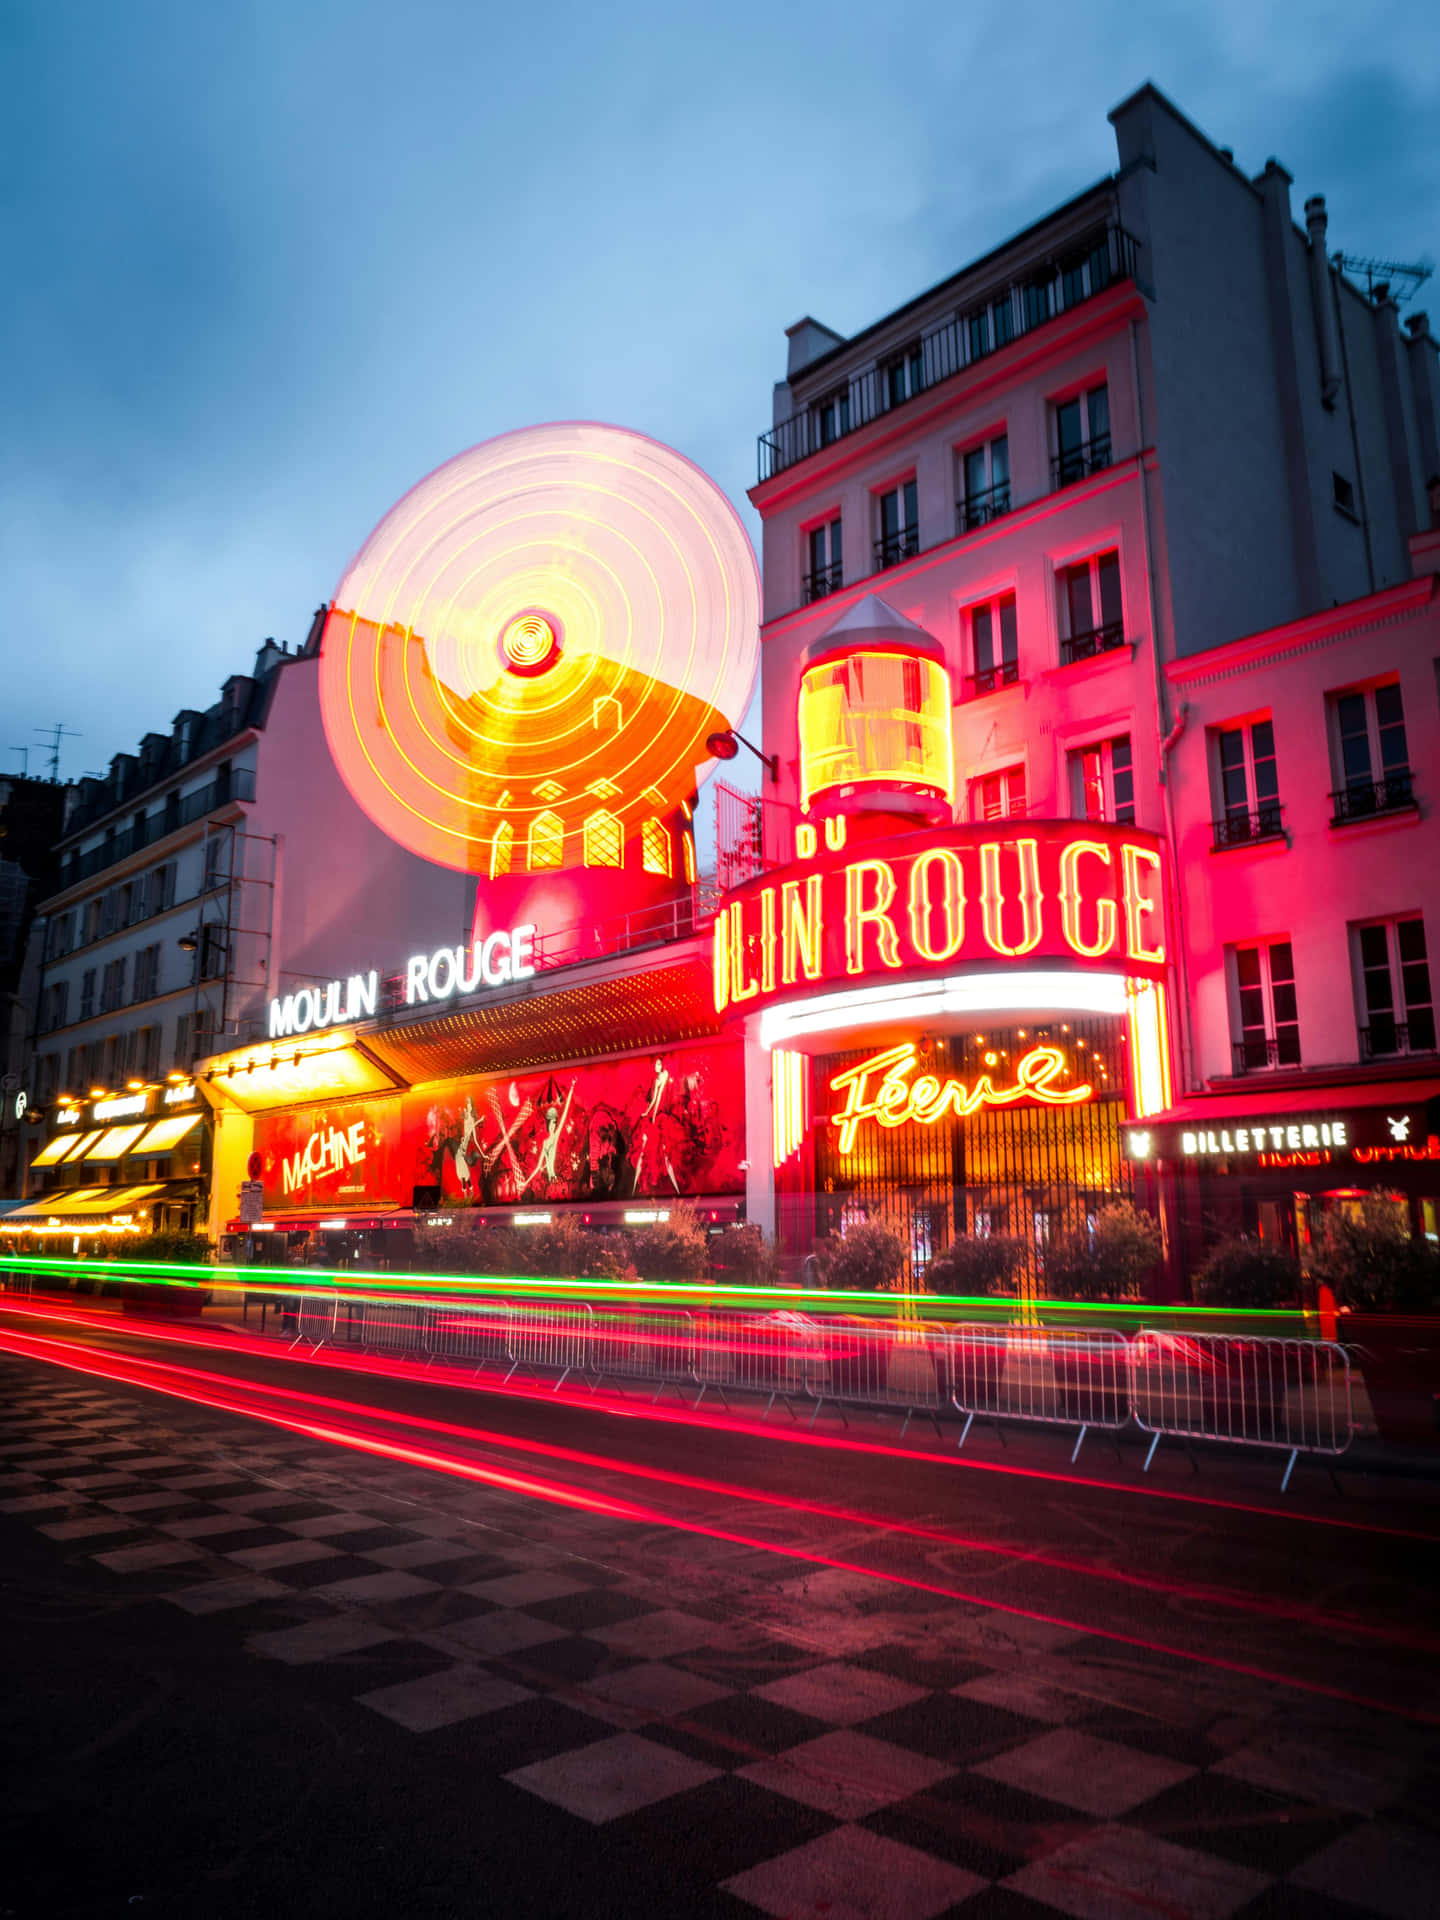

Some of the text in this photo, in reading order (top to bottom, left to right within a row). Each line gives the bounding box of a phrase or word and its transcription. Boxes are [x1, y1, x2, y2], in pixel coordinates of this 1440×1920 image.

[795, 814, 846, 859] DU
[845, 838, 1166, 974] ROUGE
[268, 924, 537, 1038] MOULIN ROUGE
[830, 1043, 1092, 1154] Féerie
[1182, 1122, 1347, 1154] BILLETTERIE
[282, 1120, 366, 1195] MACHINE
